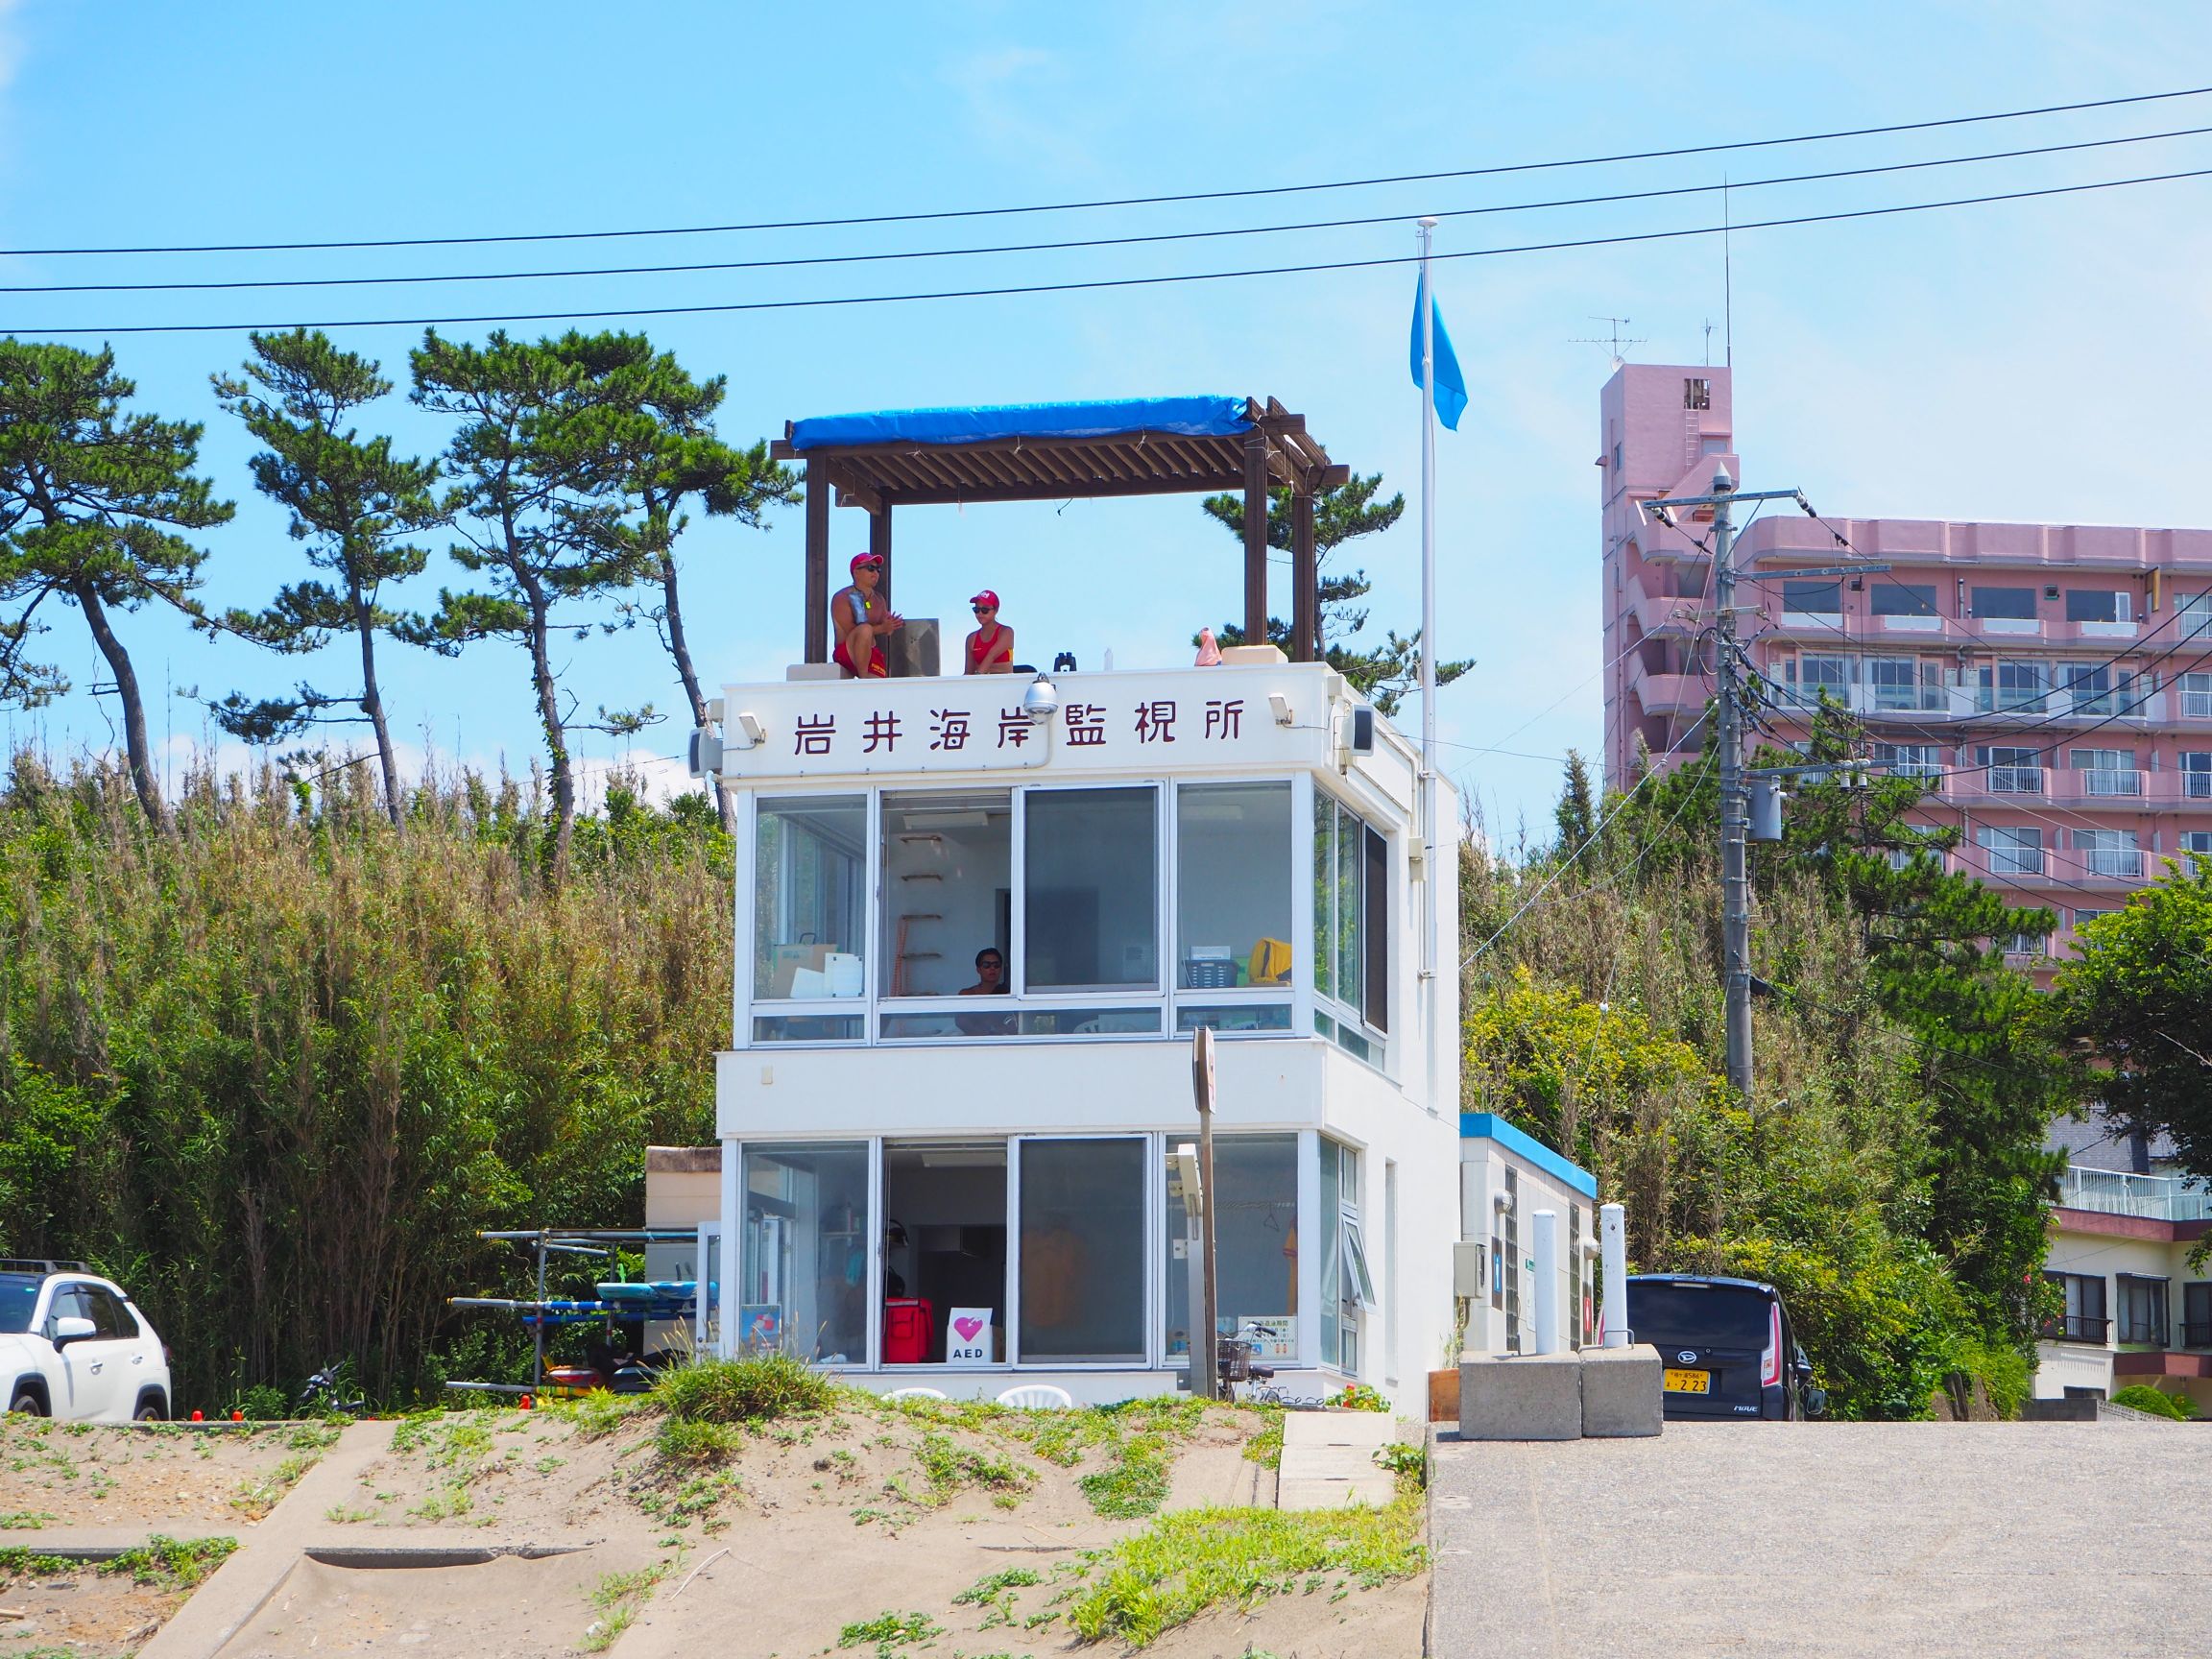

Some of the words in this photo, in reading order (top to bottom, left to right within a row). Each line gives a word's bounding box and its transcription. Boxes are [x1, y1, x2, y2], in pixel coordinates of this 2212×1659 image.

[794, 698, 1244, 756] 岩井海岸監視所
[953, 1348, 983, 1358] AED
